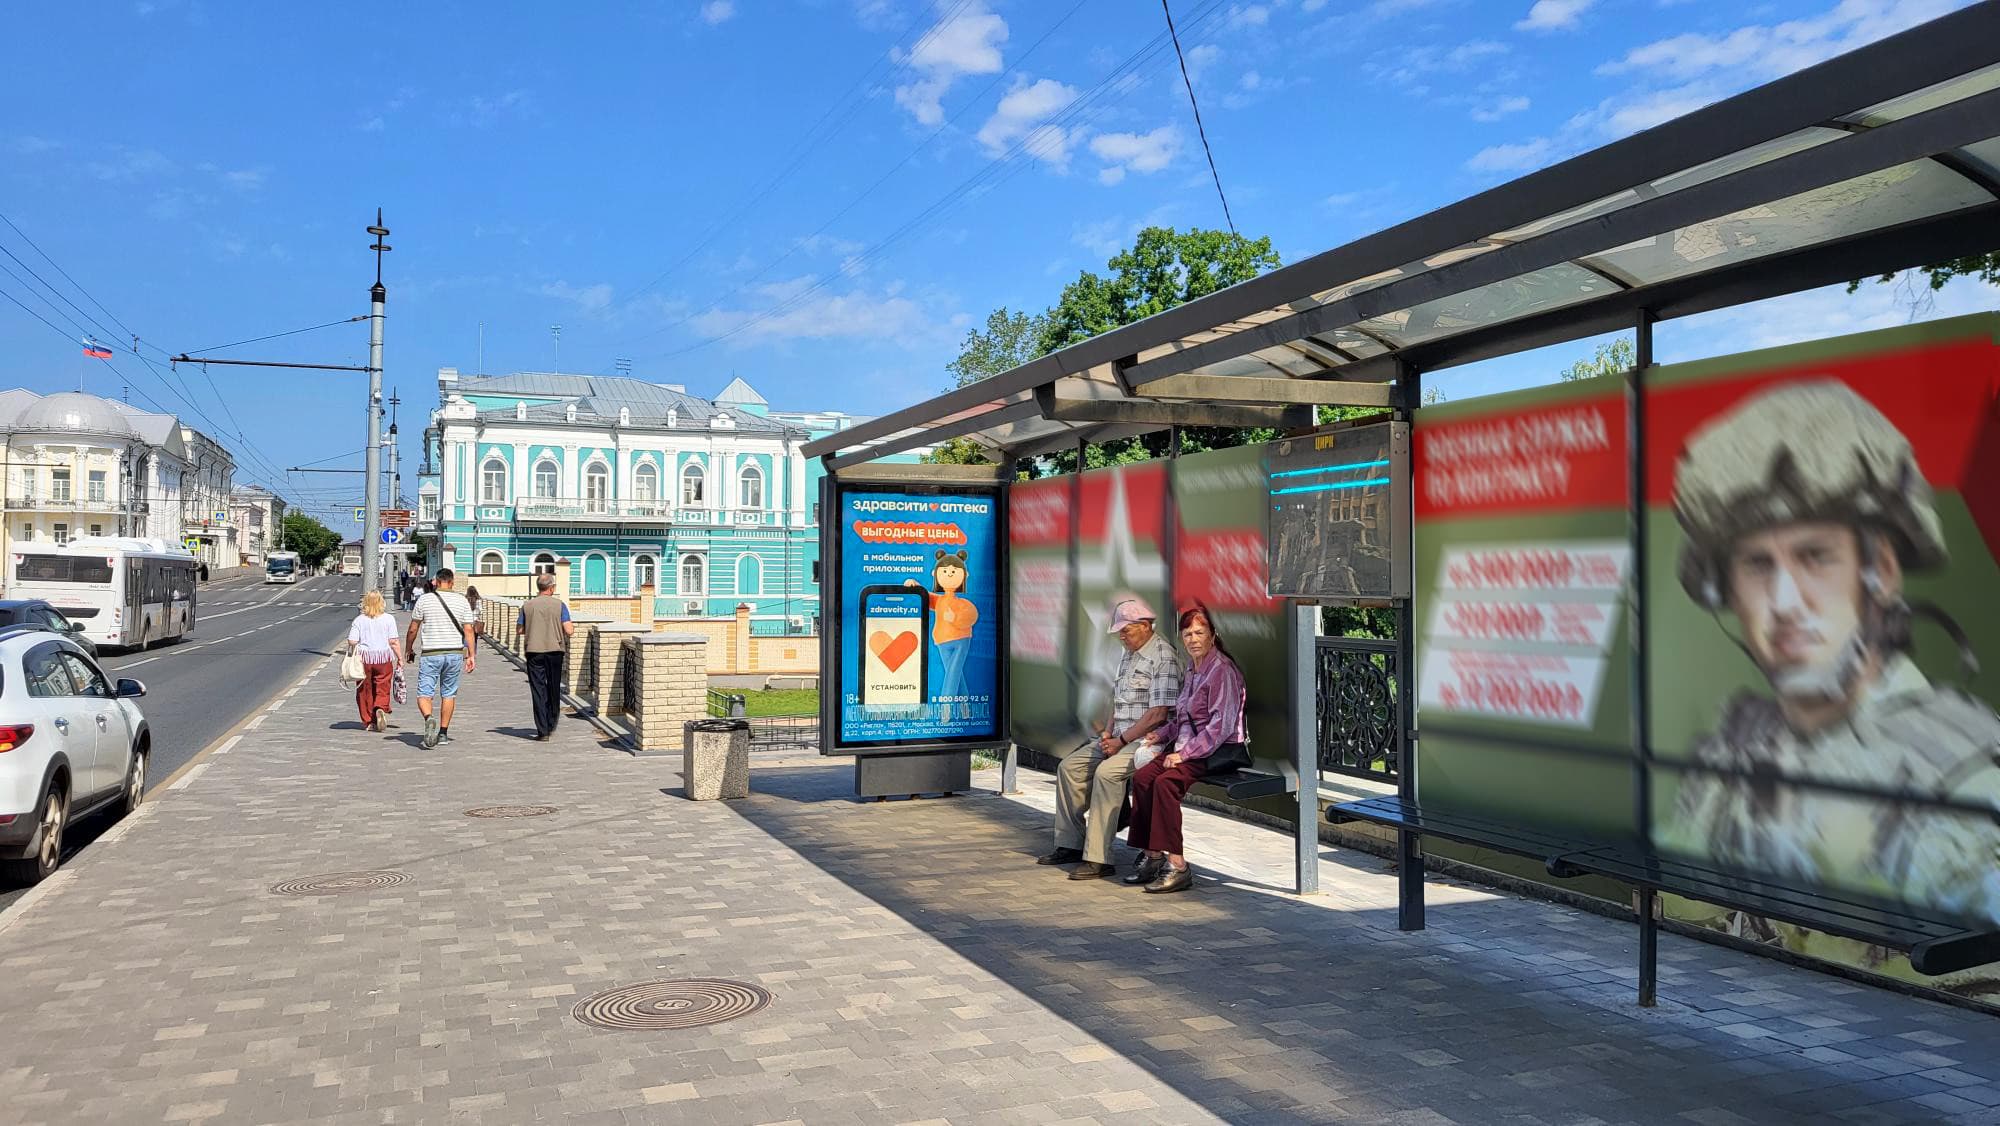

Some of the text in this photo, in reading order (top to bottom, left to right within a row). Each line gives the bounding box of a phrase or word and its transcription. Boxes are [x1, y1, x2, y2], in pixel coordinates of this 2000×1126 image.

[1315, 435, 1334, 450] ЦИРК
[852, 500, 988, 514] здравсити аптека
[861, 526, 959, 539] ВЫГОДНЫЕ ЦЕНЫ
[871, 552, 924, 562] мобильном
[863, 565, 924, 574] приложении
[870, 605, 919, 615] zdravcity.ru
[845, 693, 859, 705] 18+
